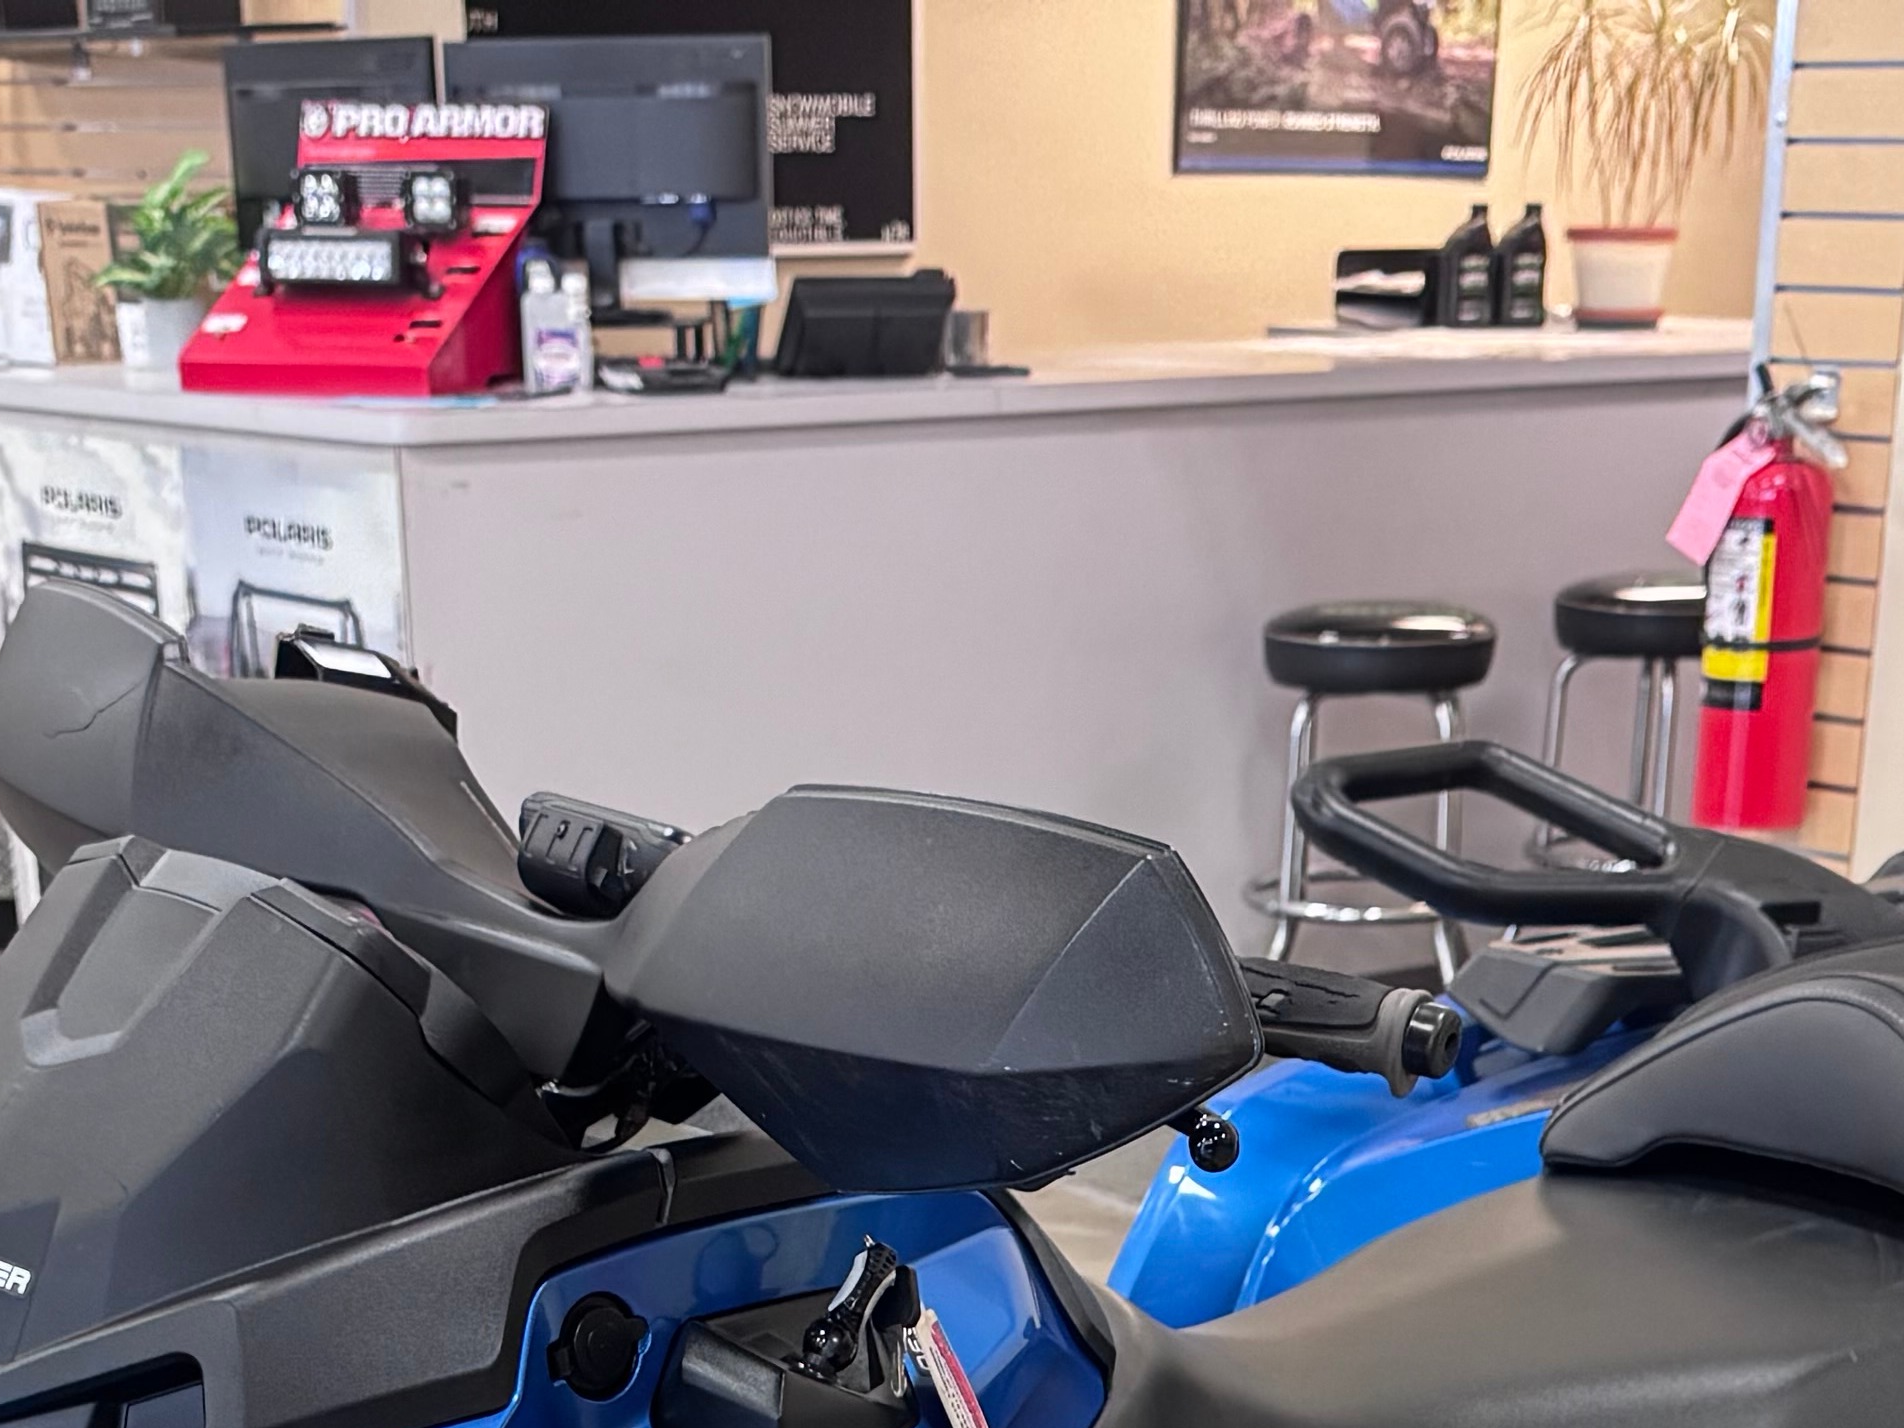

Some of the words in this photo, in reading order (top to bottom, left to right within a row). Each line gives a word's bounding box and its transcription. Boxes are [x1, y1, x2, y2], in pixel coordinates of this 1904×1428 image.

[331, 104, 409, 138] PRO
[411, 104, 545, 139] ARMOR
[41, 484, 124, 520] POLARIS
[243, 514, 334, 551] POLARIS
